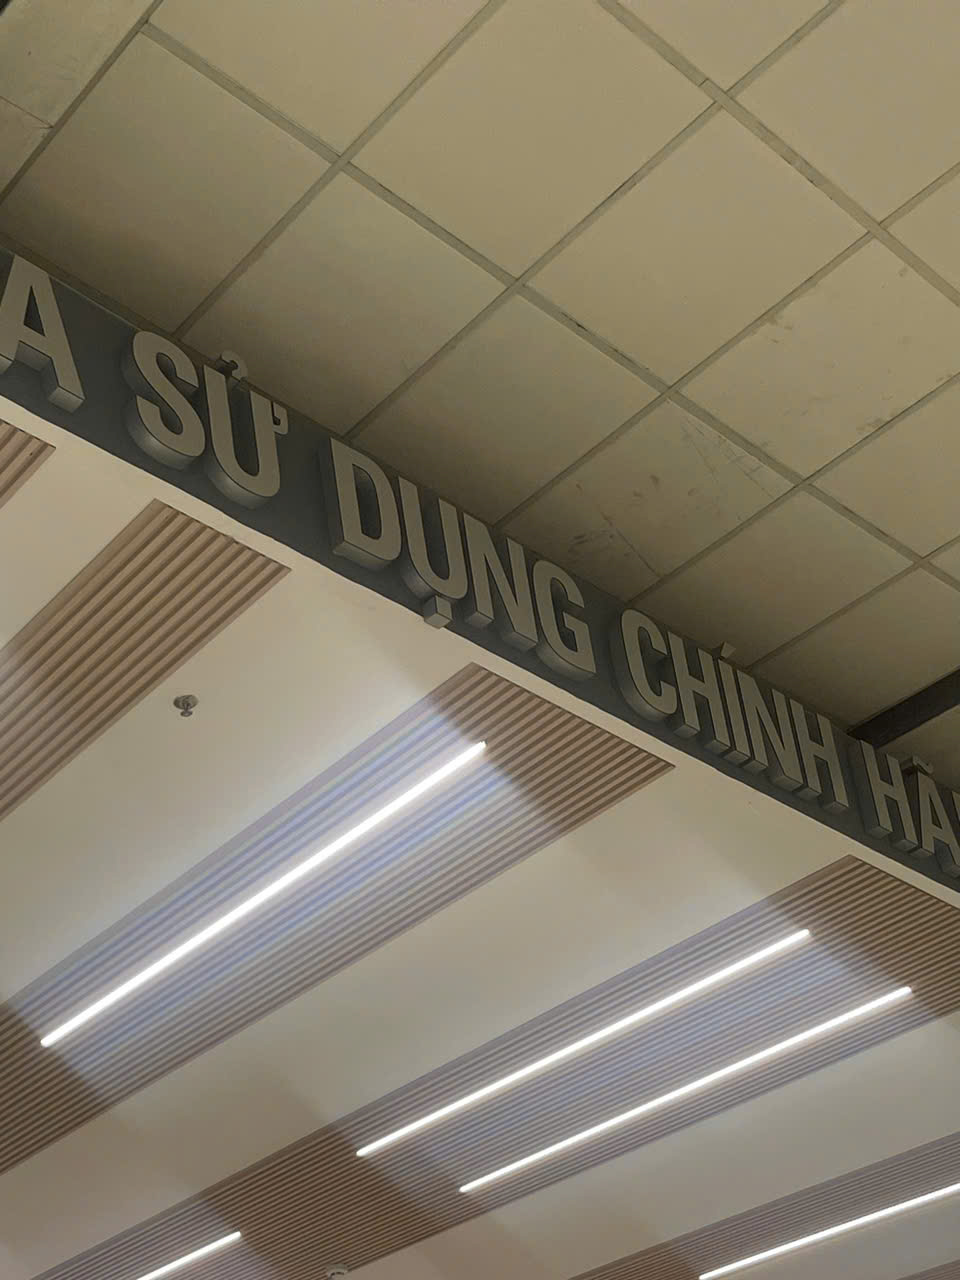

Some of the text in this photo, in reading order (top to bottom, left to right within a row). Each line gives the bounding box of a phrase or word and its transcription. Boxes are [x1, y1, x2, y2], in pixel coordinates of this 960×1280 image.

[126, 331, 289, 502] SỬ
[324, 436, 598, 680] DỤNG
[614, 607, 850, 812] CHÍNH
[860, 738, 960, 874] HÃ
